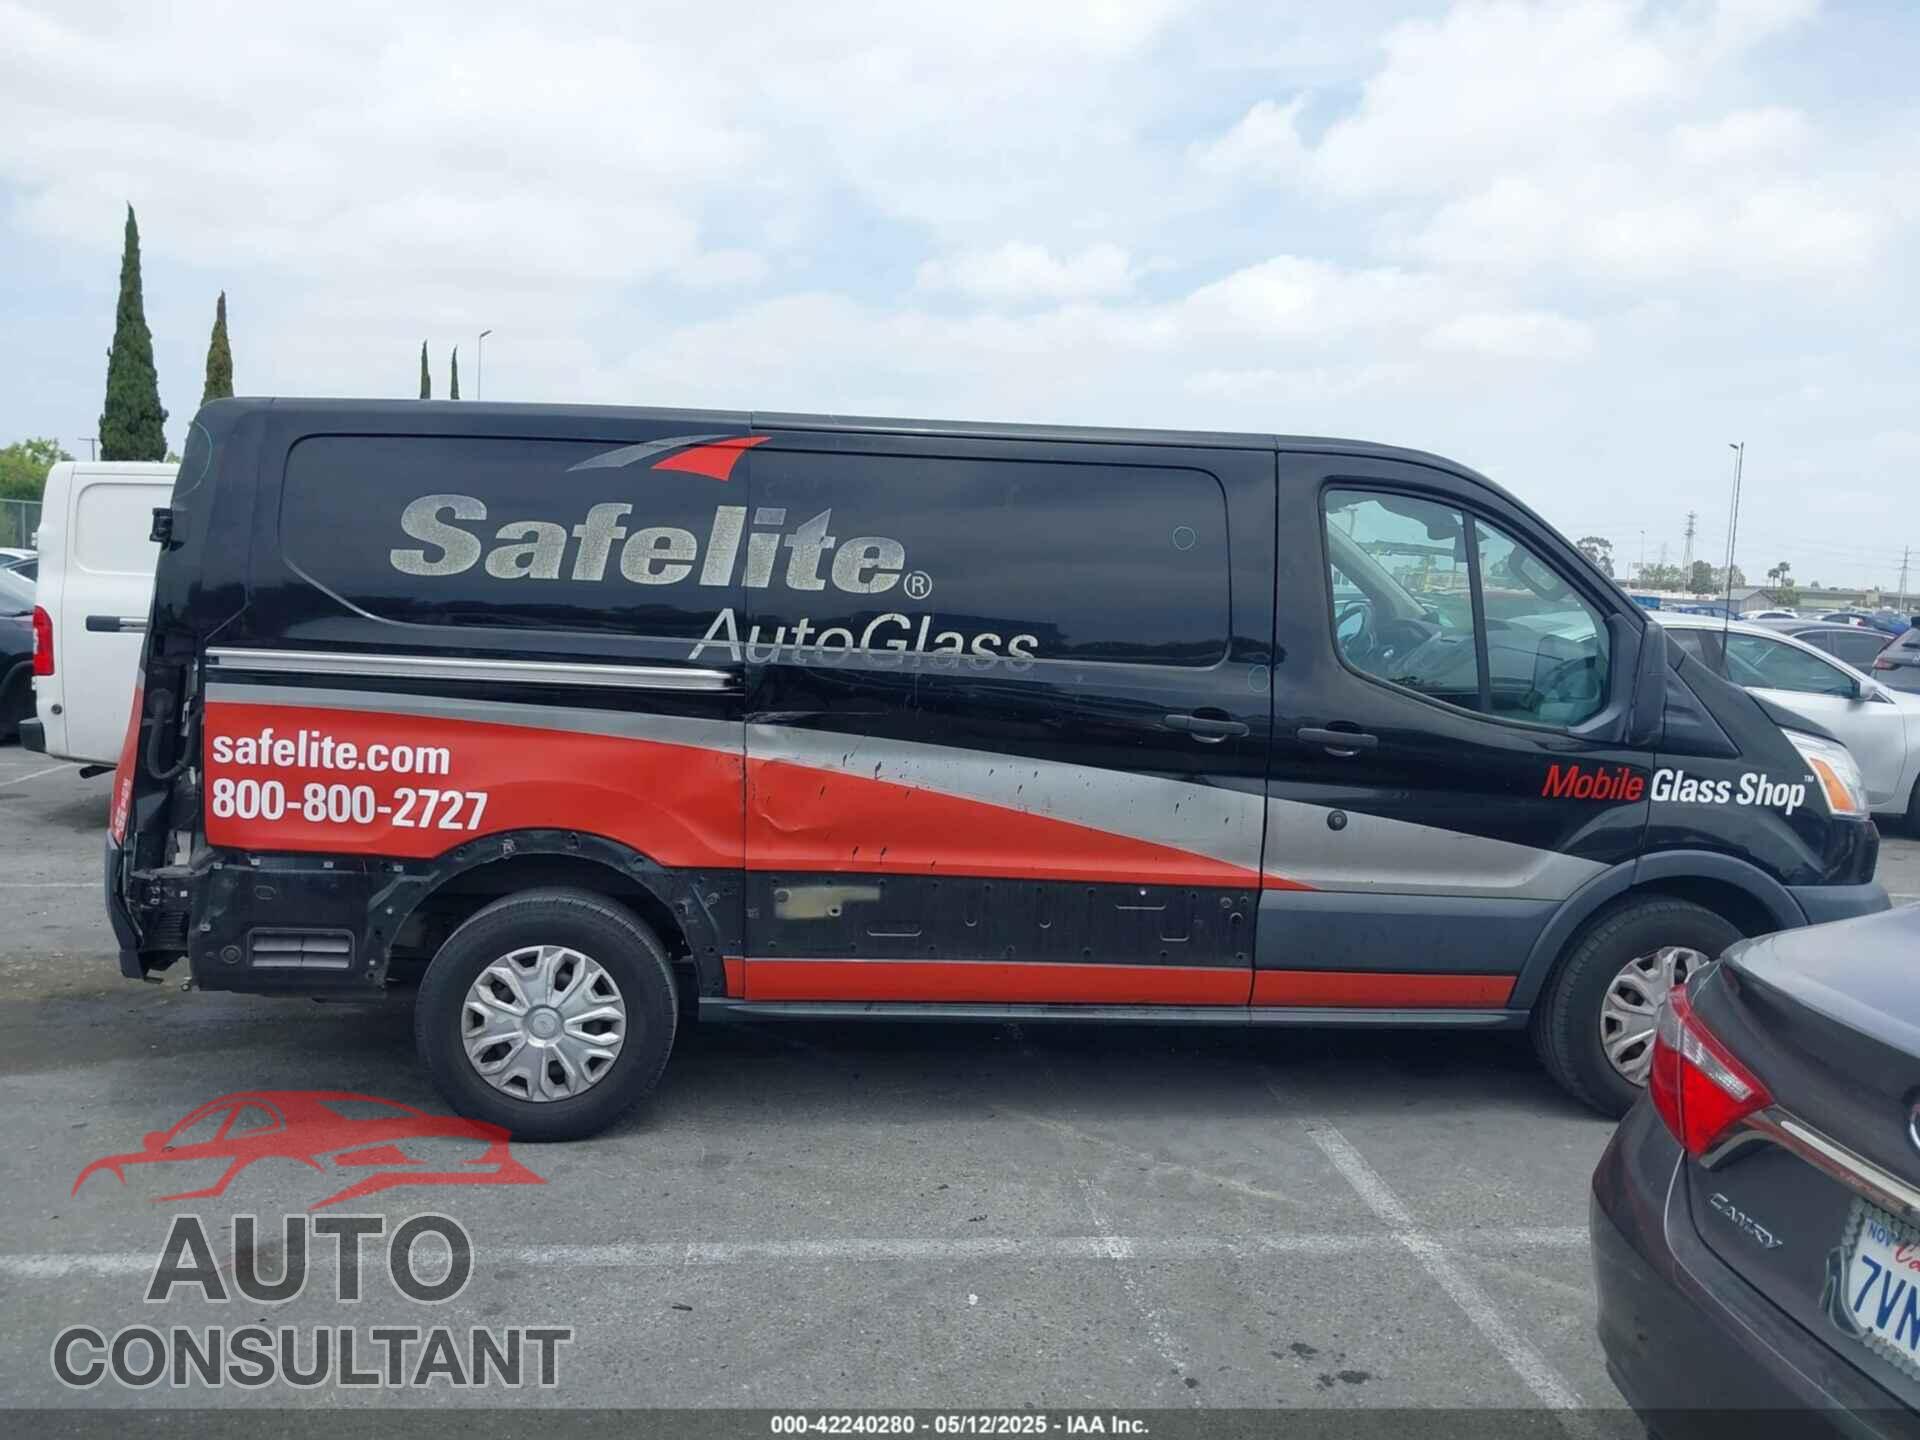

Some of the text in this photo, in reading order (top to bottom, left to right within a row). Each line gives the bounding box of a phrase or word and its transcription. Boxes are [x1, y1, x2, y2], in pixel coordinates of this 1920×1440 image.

[688, 607, 1039, 672] AutoGlass
[212, 728, 450, 775] safelite.com
[212, 778, 488, 831] 800-800-2727
[1541, 763, 1645, 801] Mobile
[1650, 768, 1732, 804] Glass
[1735, 773, 1806, 816] Shop
